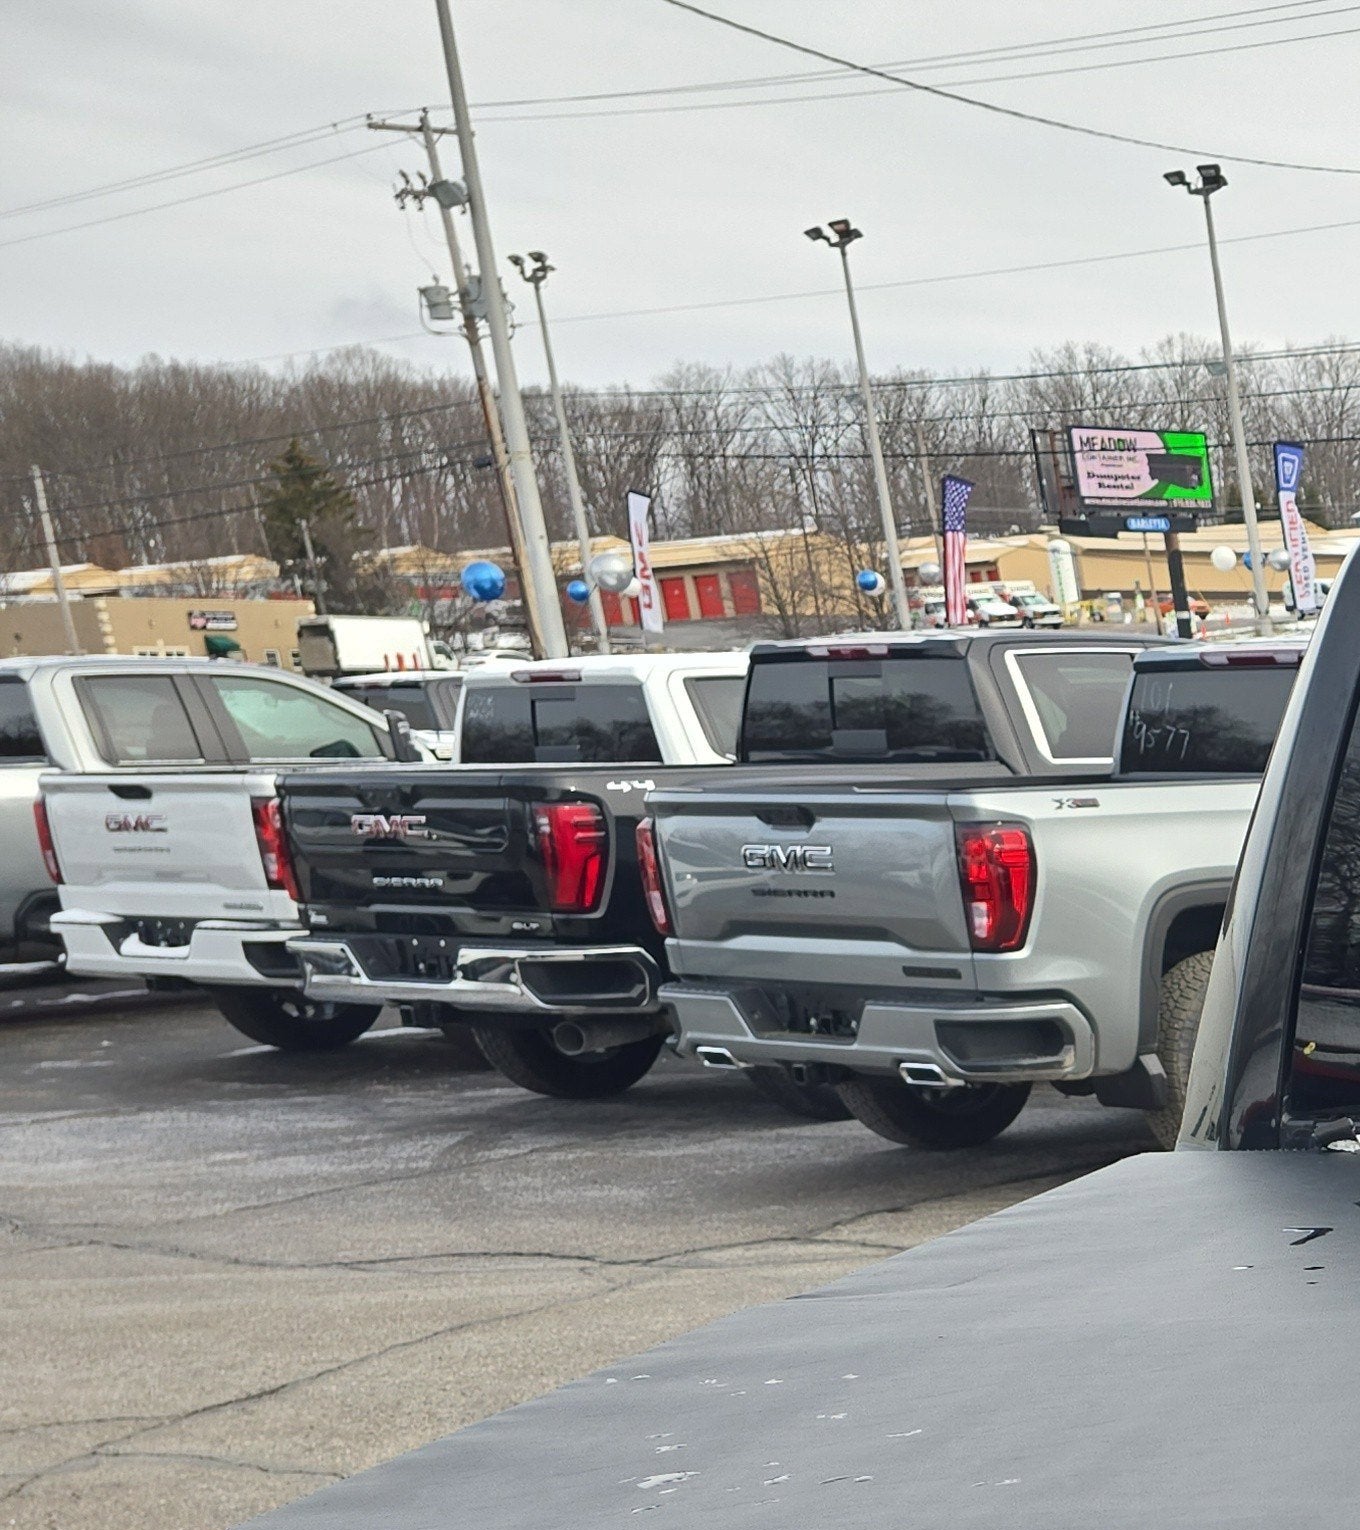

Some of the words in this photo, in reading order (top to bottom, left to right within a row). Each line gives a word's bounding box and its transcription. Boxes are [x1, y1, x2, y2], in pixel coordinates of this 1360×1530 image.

[1080, 435, 1138, 452] MEADOW
[105, 814, 168, 832] GMC
[351, 814, 428, 838] GMC
[741, 844, 833, 872] GMC
